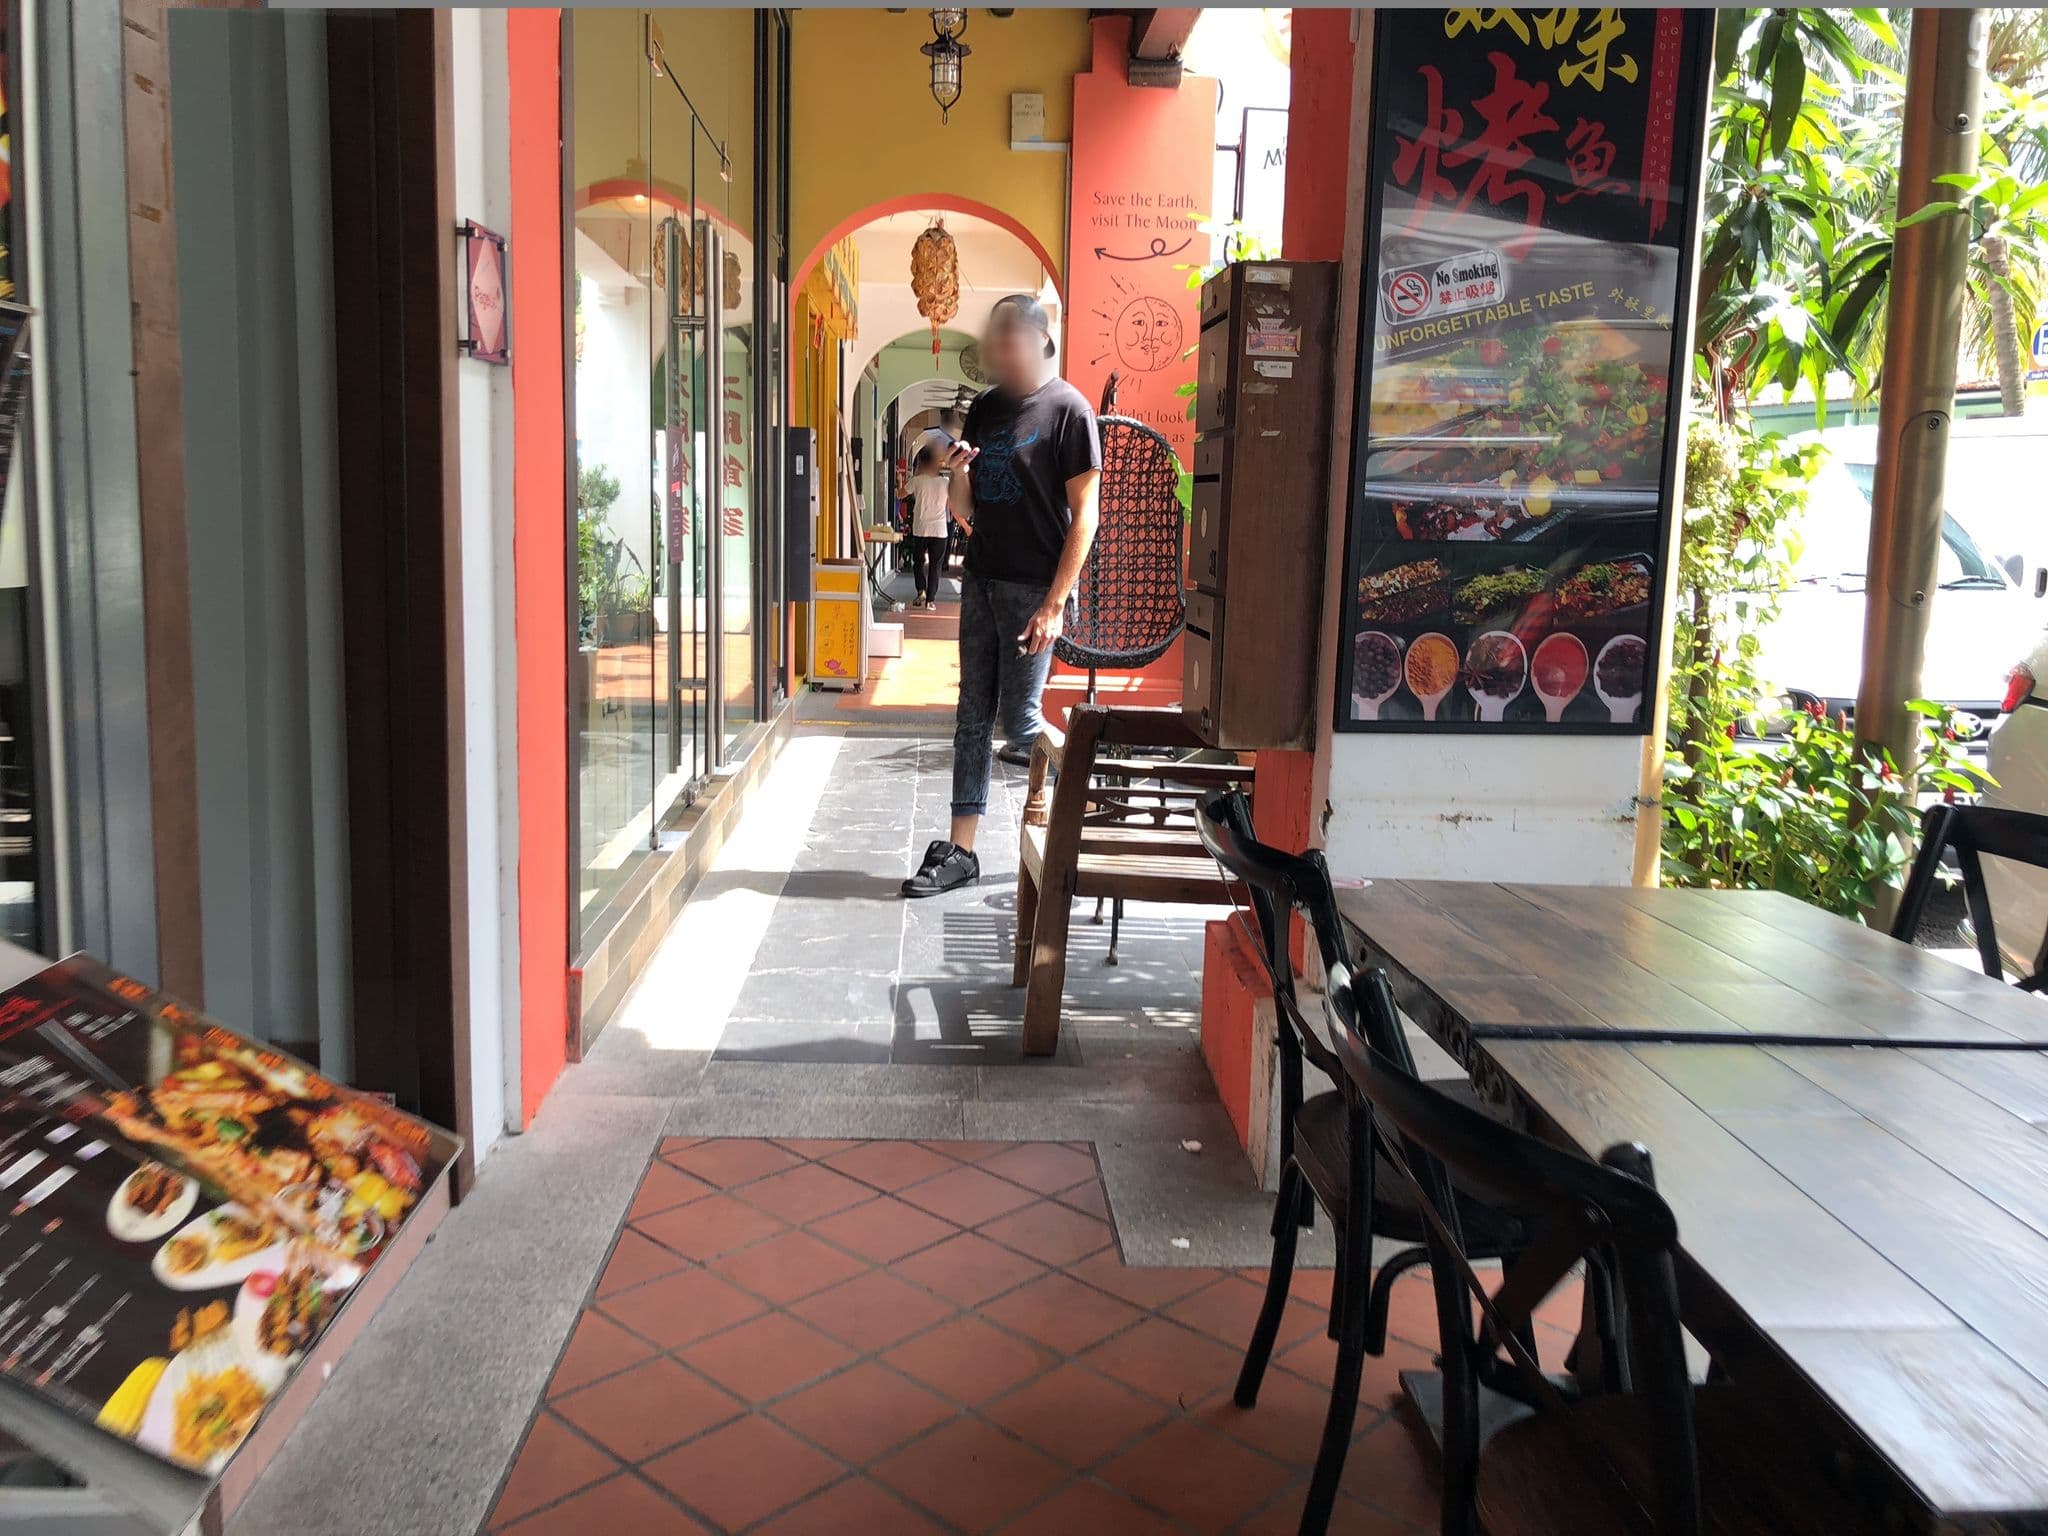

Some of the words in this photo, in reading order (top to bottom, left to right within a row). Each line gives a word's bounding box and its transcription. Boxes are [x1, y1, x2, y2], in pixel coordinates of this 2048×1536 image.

[1093, 191, 1126, 206] Save
[1130, 193, 1153, 208] the
[1158, 193, 1199, 210] Earth,
[1091, 214, 1119, 228] visit
[1126, 213, 1151, 229] The
[1156, 215, 1197, 230] Moon
[1435, 269, 1452, 288] No
[1453, 262, 1499, 284] Smoking
[1438, 281, 1496, 306] 禁止吸烟
[1375, 297, 1533, 352] UNFORGETTABLE
[1536, 280, 1596, 309] TASTE
[1156, 408, 1184, 425] look
